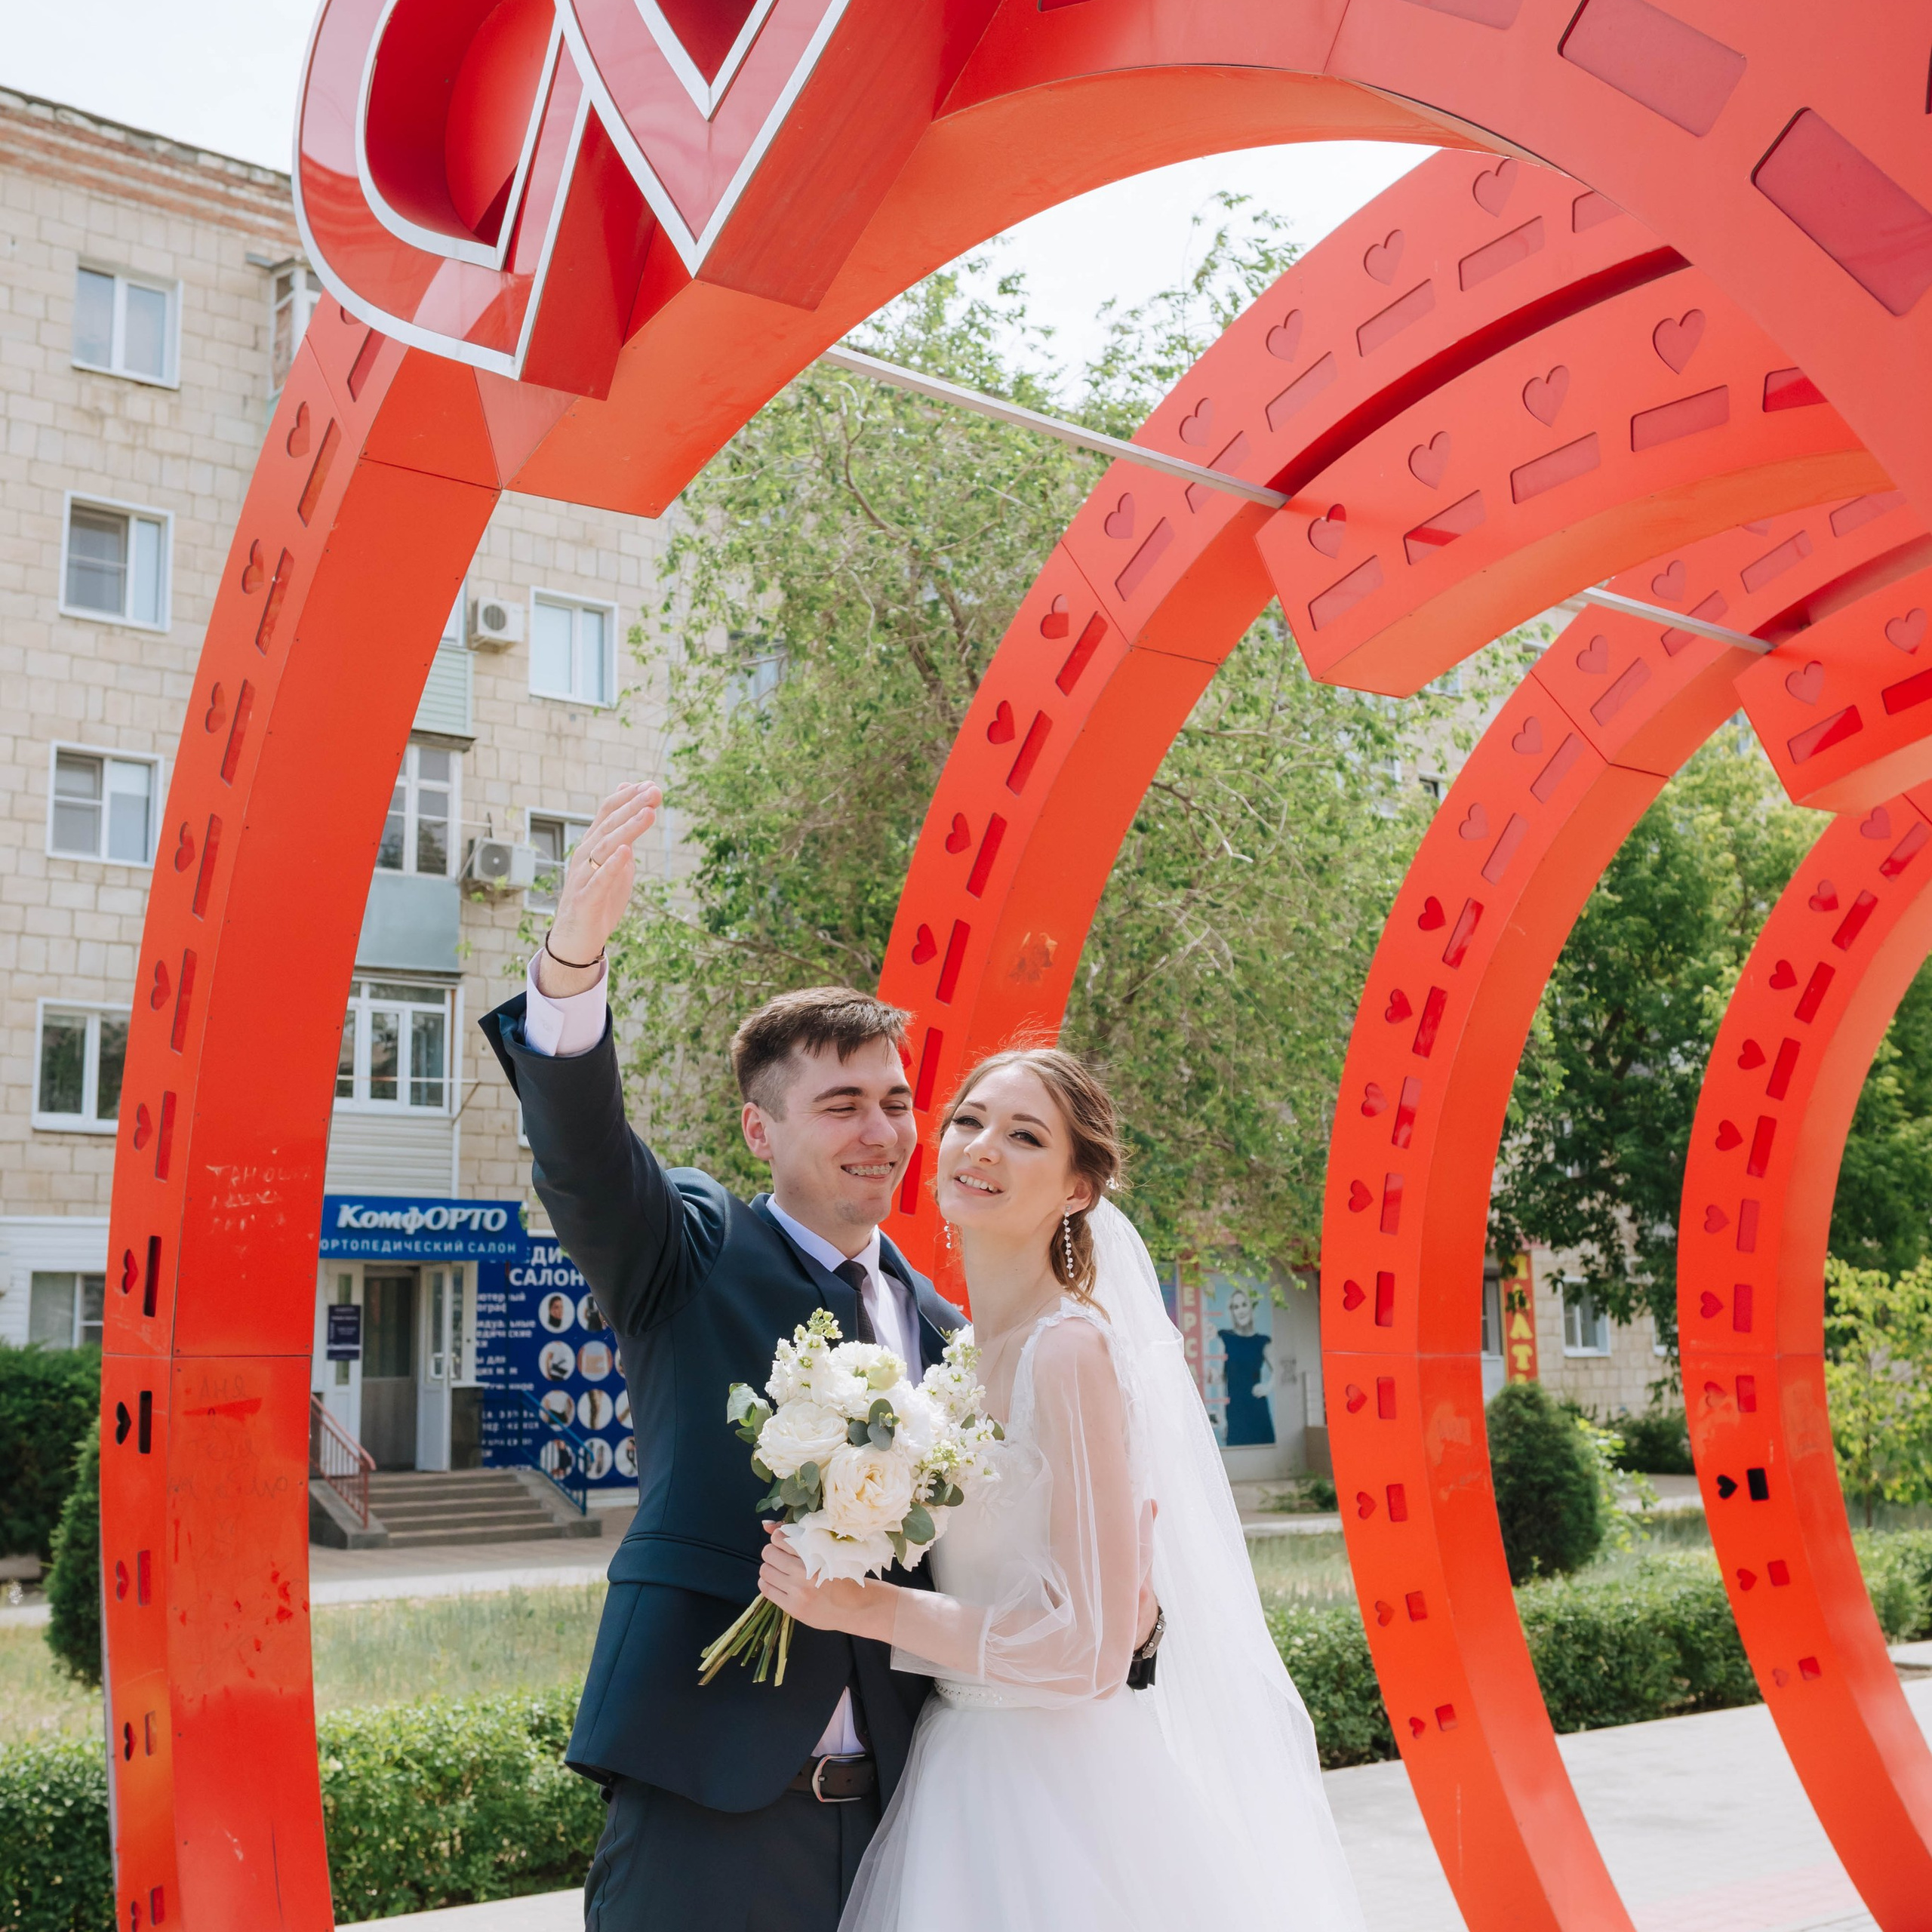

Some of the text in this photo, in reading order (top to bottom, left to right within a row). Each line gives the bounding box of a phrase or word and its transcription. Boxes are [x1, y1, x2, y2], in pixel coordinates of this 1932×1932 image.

[337, 1204, 508, 1235] КомфОРТО
[320, 1238, 517, 1254] ОРТОПЕДИЧЕСКИЙ САЛОН
[509, 1268, 585, 1286] САЛОН
